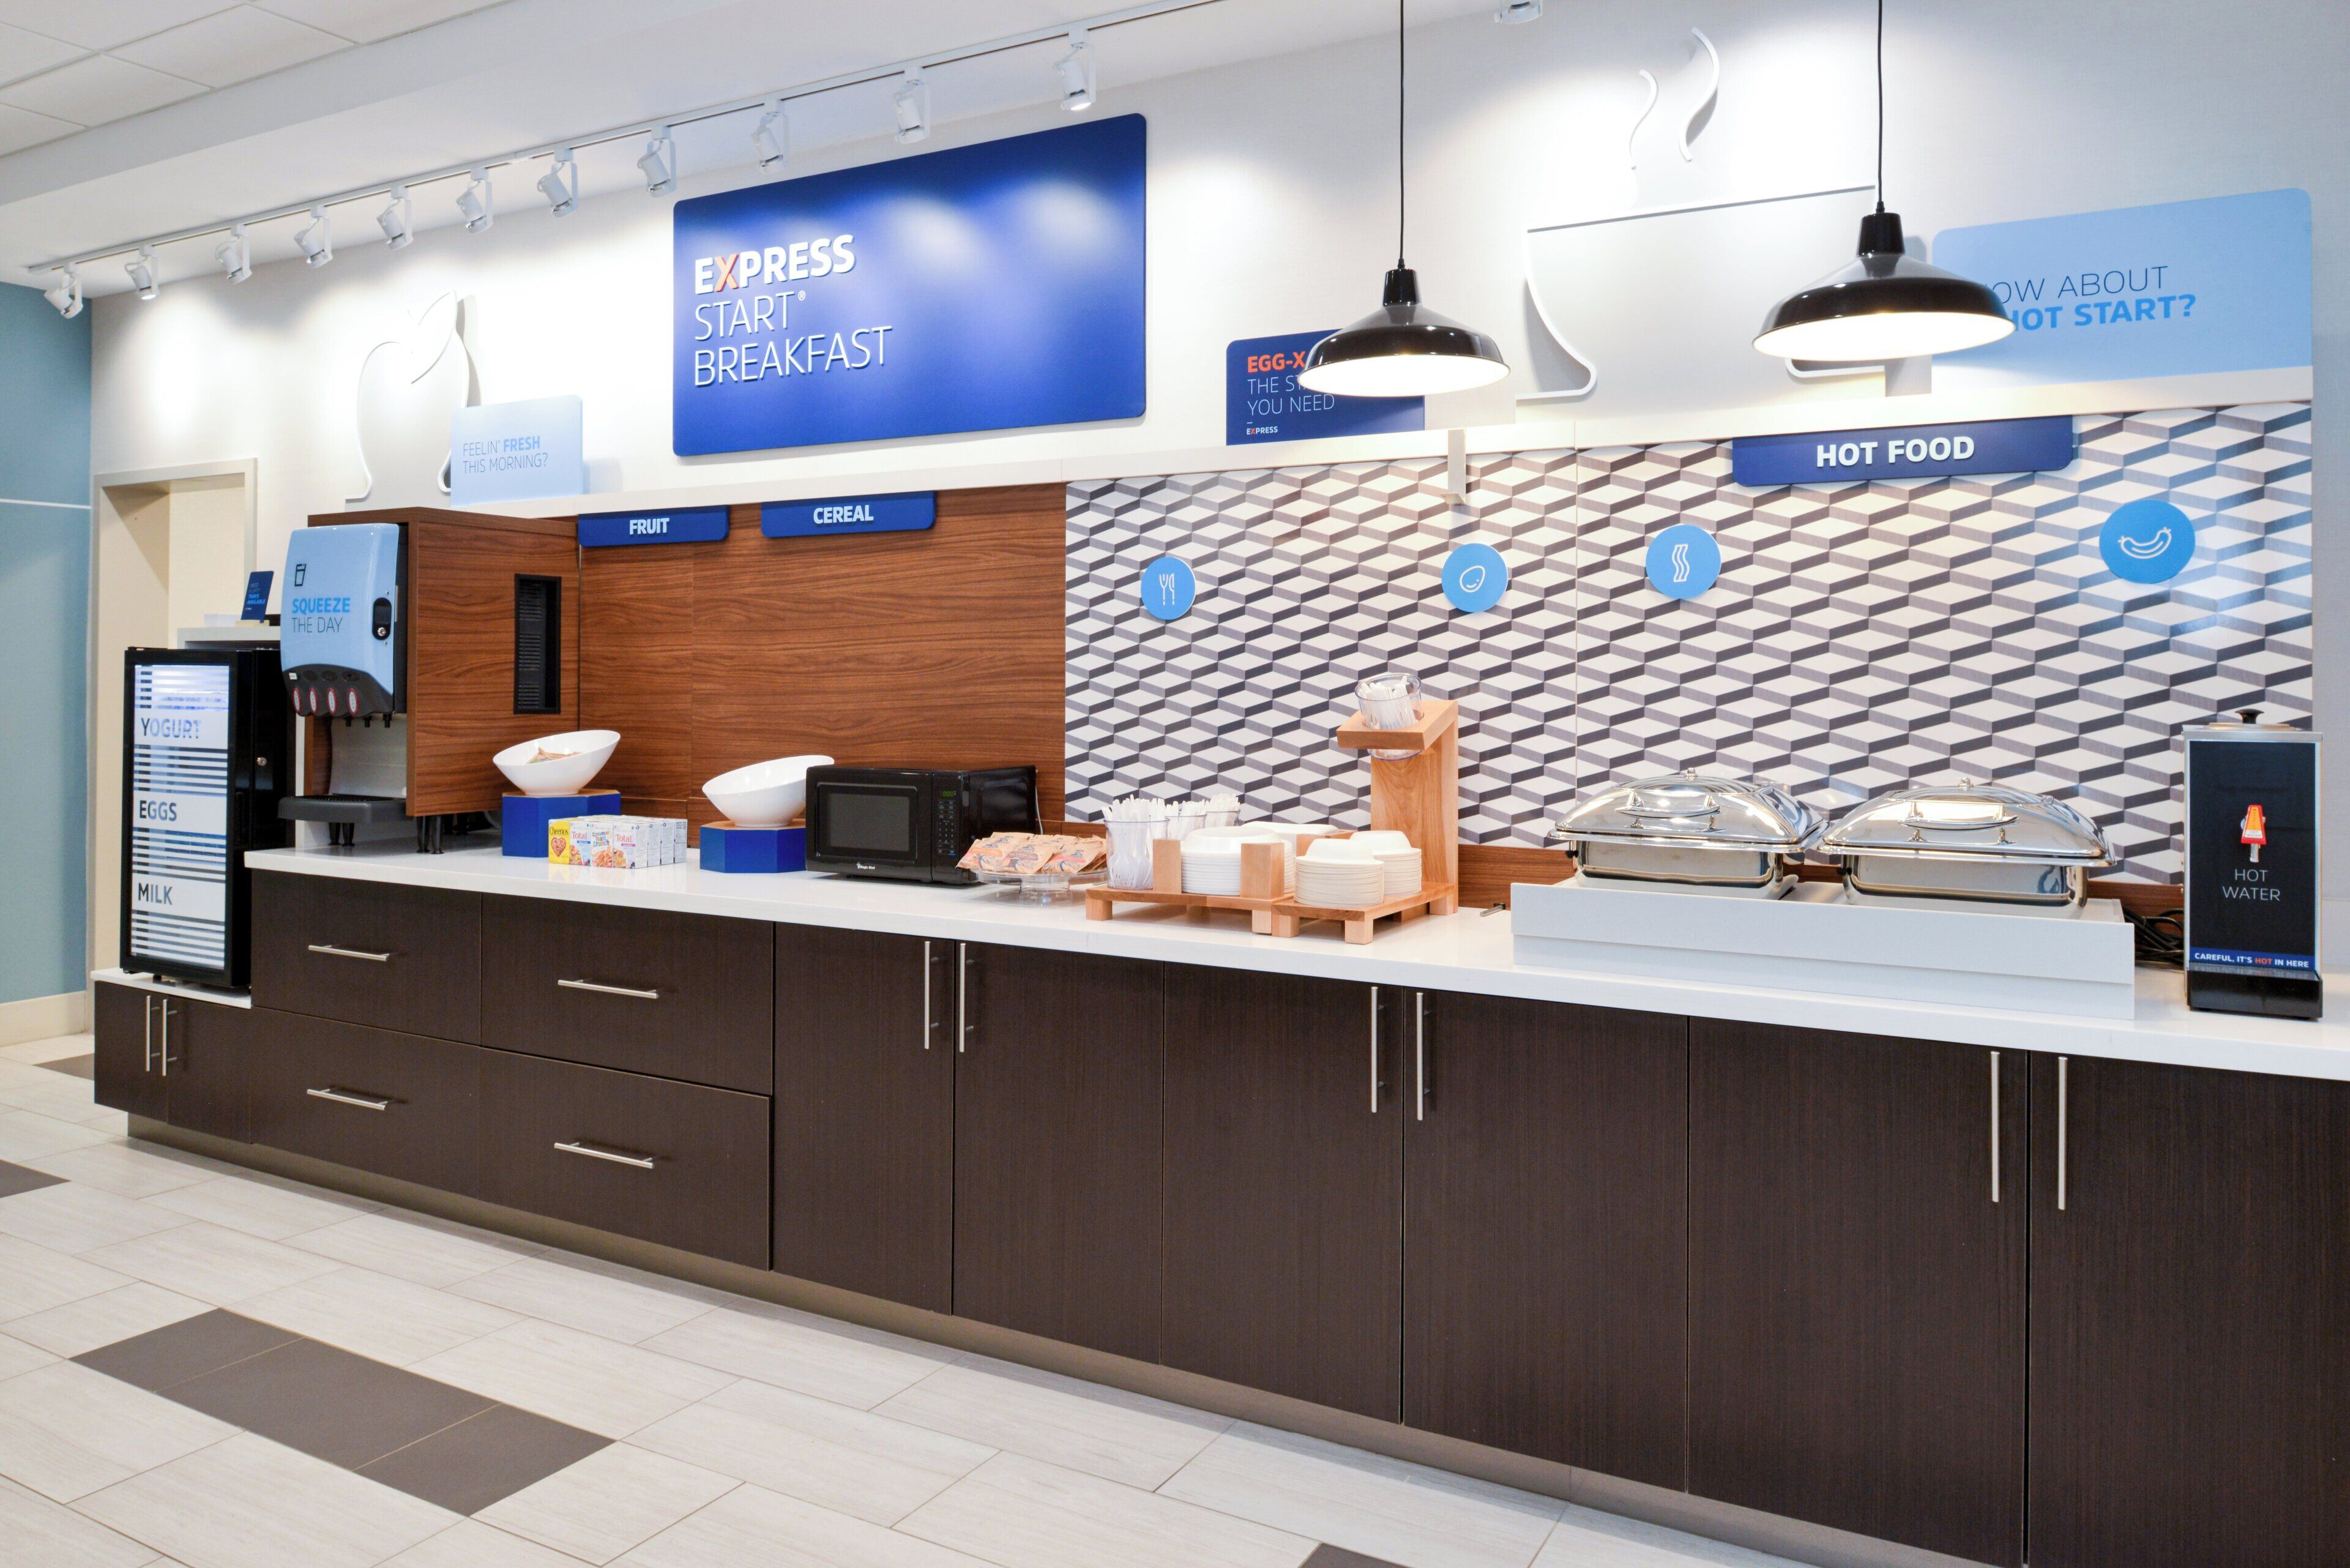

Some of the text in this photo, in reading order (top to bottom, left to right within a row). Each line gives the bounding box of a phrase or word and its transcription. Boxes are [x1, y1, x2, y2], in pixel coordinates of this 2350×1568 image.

[695, 234, 856, 294] EXPRESS
[1985, 266, 2168, 304] OW ABOUT
[2074, 293, 2196, 327] START?
[695, 326, 893, 387] BREAKFAST
[1247, 351, 1306, 373] EGG-X
[1247, 376, 1279, 395] THE
[1247, 394, 1335, 416] YOU NEED
[1246, 426, 1278, 435] EXPRESS
[463, 436, 540, 457] FEELIN' FRESH
[1816, 436, 1975, 467] HOT FOOD
[463, 452, 548, 474] THIS MORNING?
[813, 504, 874, 524] CEREAL
[629, 517, 670, 535] FRUIT
[291, 597, 351, 614] SQUEEZE
[291, 616, 343, 633] THE DAY
[141, 717, 201, 739] YOGURT
[140, 800, 177, 821] EGGS
[2235, 868, 2269, 882] HOT
[138, 883, 173, 905] MILK
[2222, 886, 2280, 901] WATER
